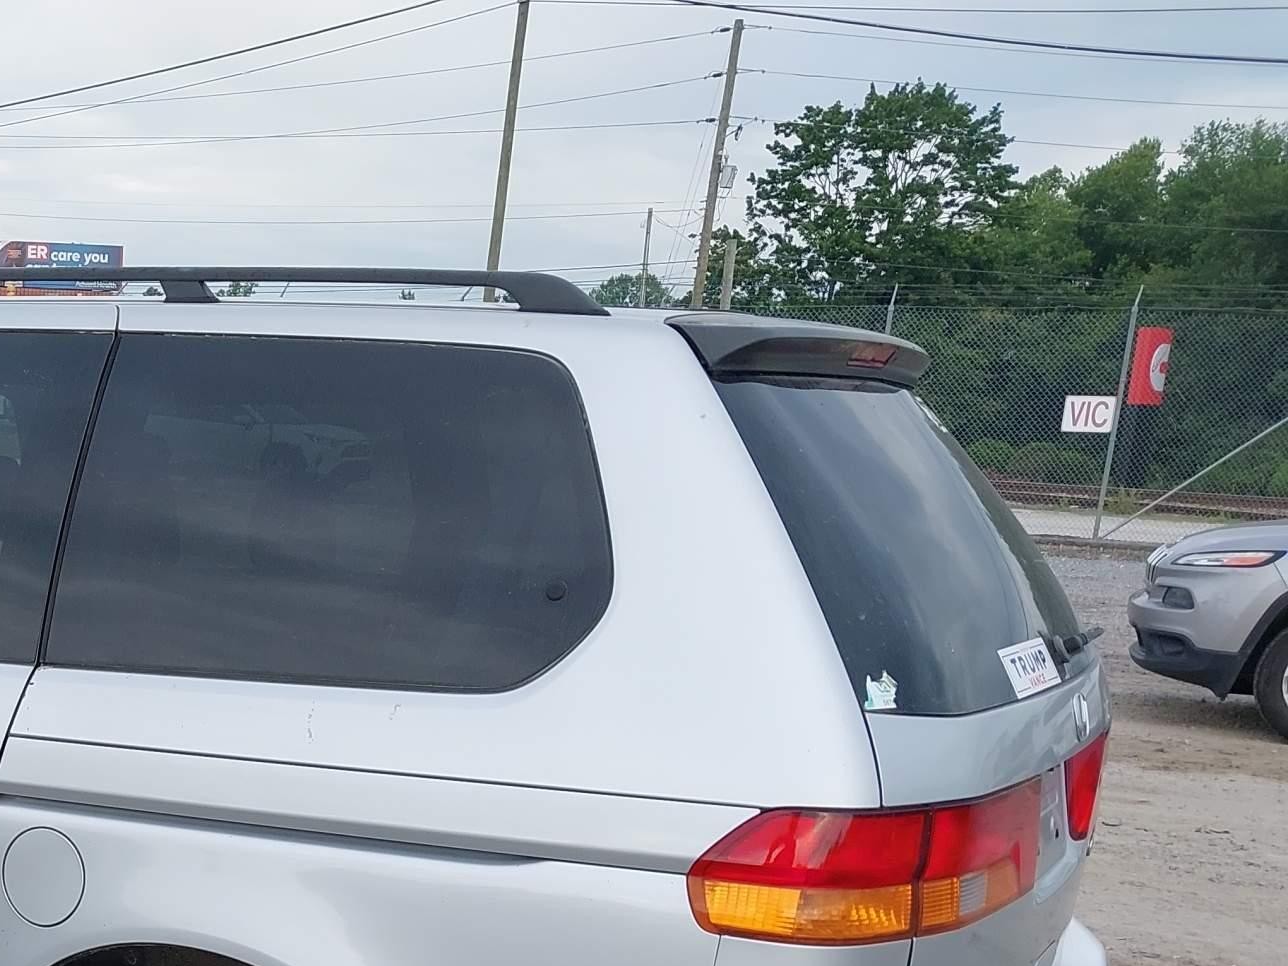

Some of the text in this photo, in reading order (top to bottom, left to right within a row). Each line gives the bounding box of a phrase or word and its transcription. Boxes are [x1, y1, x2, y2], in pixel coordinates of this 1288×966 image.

[27, 244, 109, 265] ER care you
[1070, 400, 1109, 428] VIC
[1010, 649, 1047, 679] TRUMP
